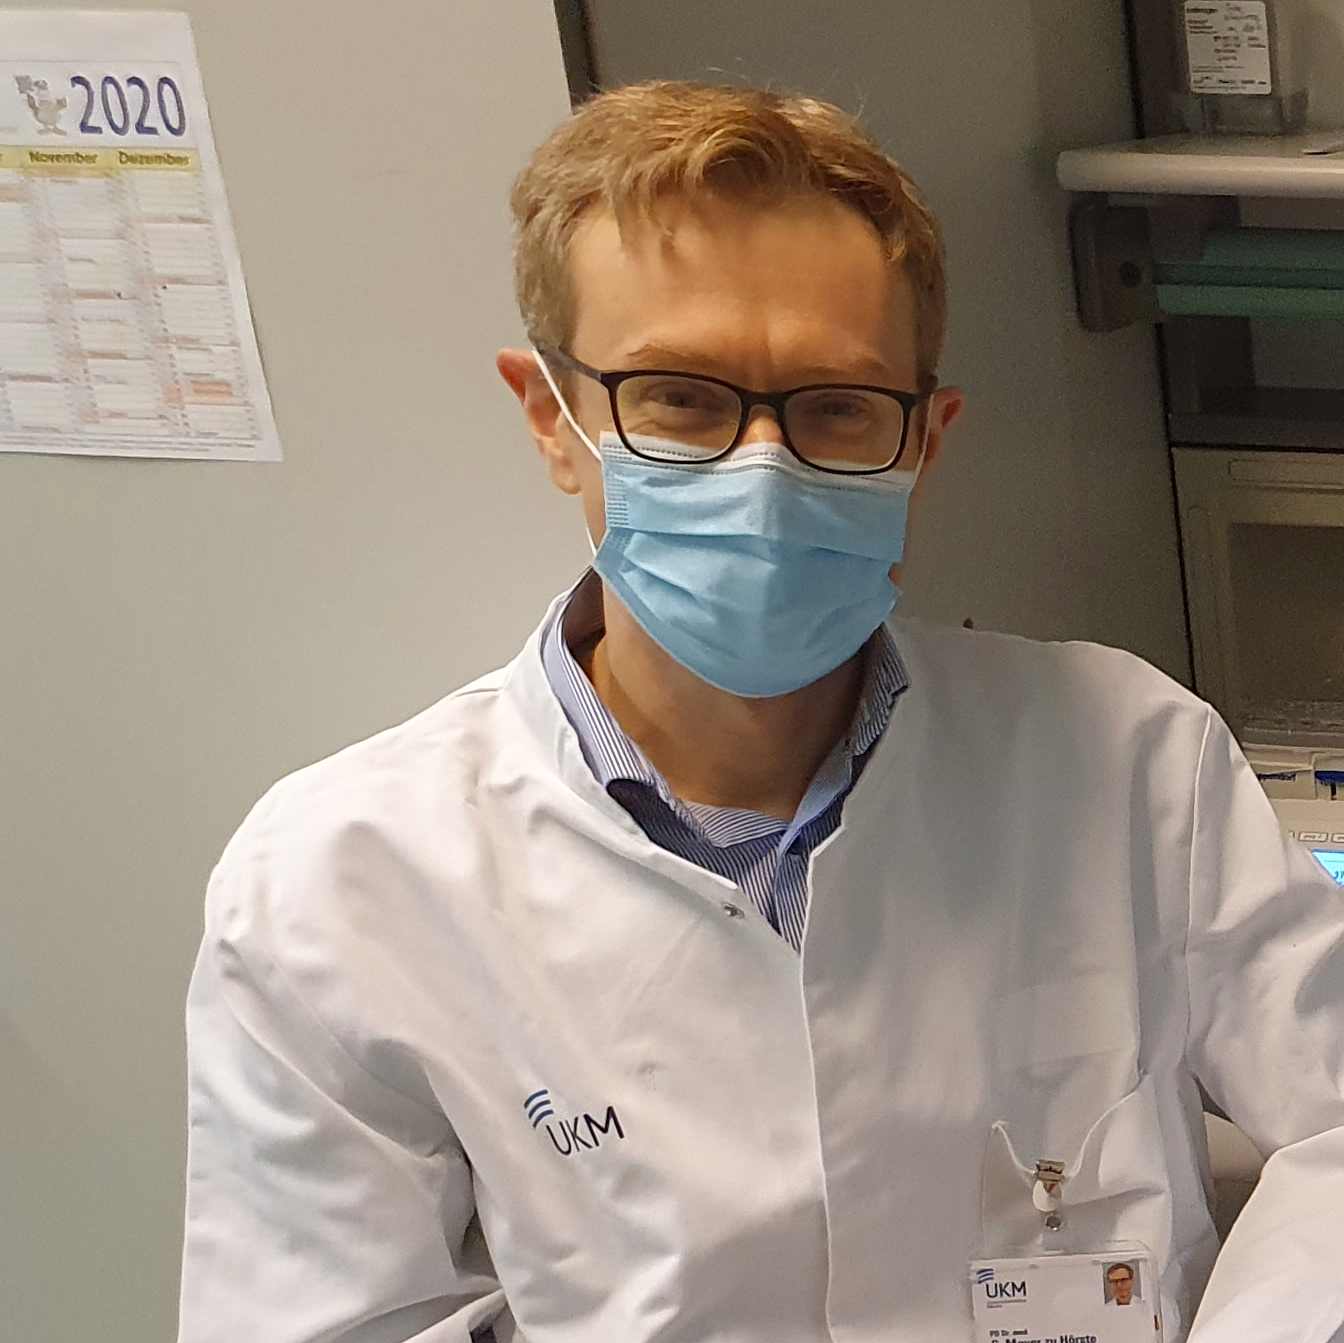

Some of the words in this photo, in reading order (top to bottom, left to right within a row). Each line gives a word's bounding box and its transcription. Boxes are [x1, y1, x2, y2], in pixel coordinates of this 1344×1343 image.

[70, 75, 187, 137] 2020
[29, 151, 99, 165] November
[545, 1105, 625, 1156] UKM
[986, 1281, 1028, 1299] UKM
